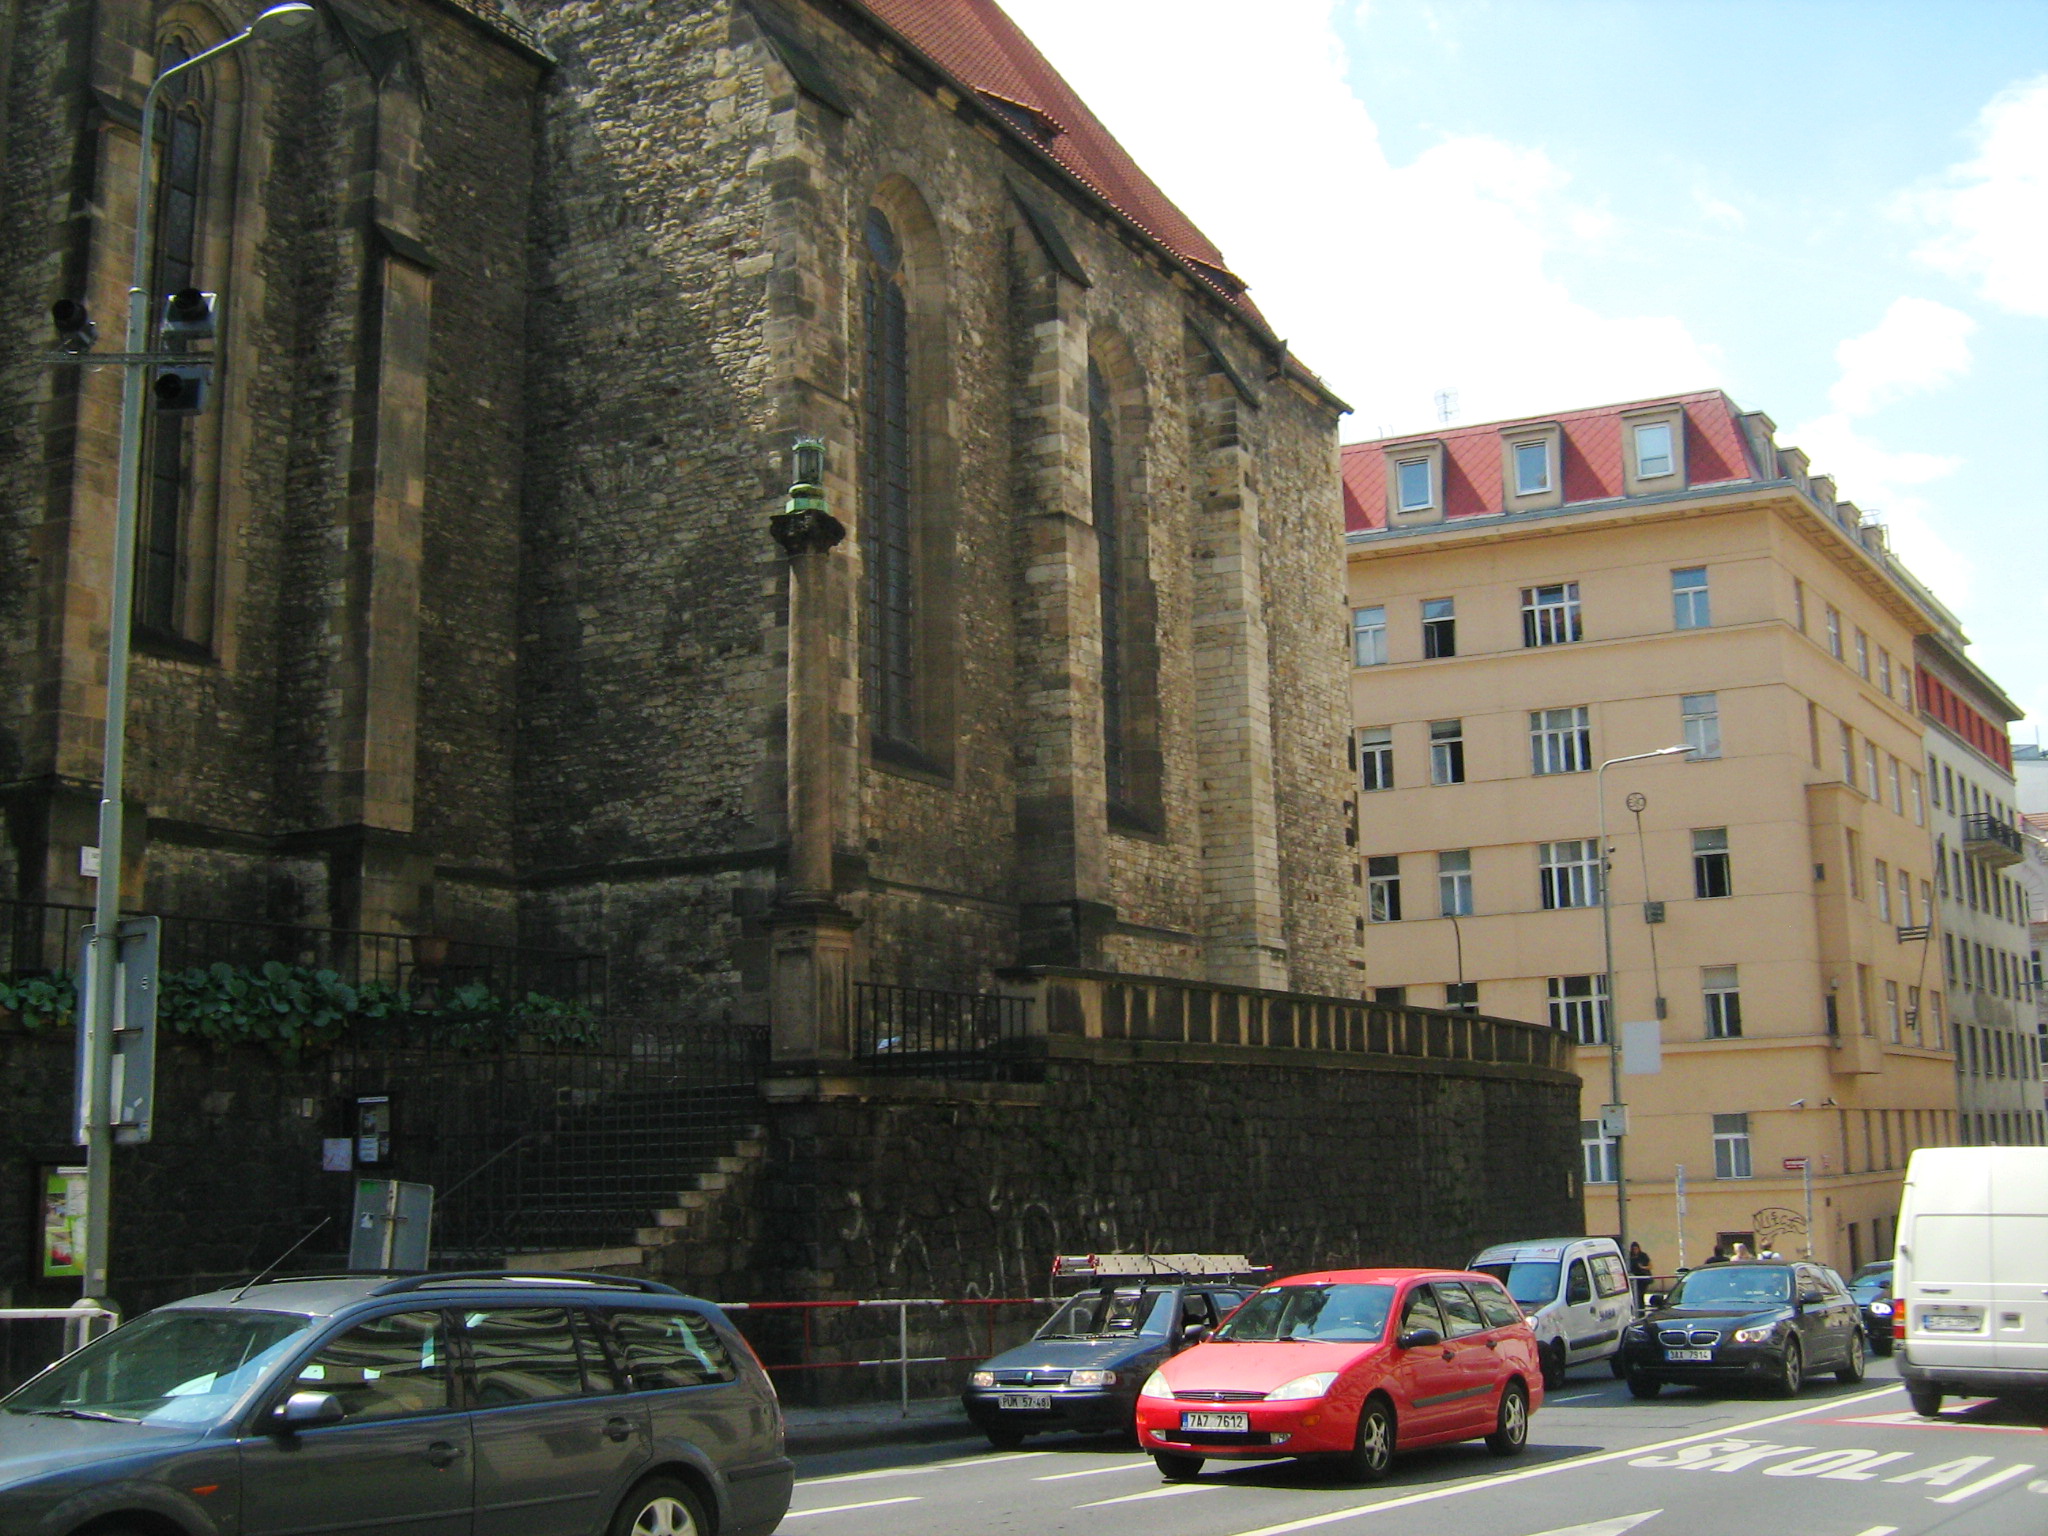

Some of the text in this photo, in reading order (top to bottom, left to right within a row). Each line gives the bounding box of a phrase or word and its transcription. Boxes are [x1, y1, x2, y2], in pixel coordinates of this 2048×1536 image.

[1190, 1414, 1243, 1428] 7A7 7612
[1627, 1437, 1996, 1486] ŠKOLA
